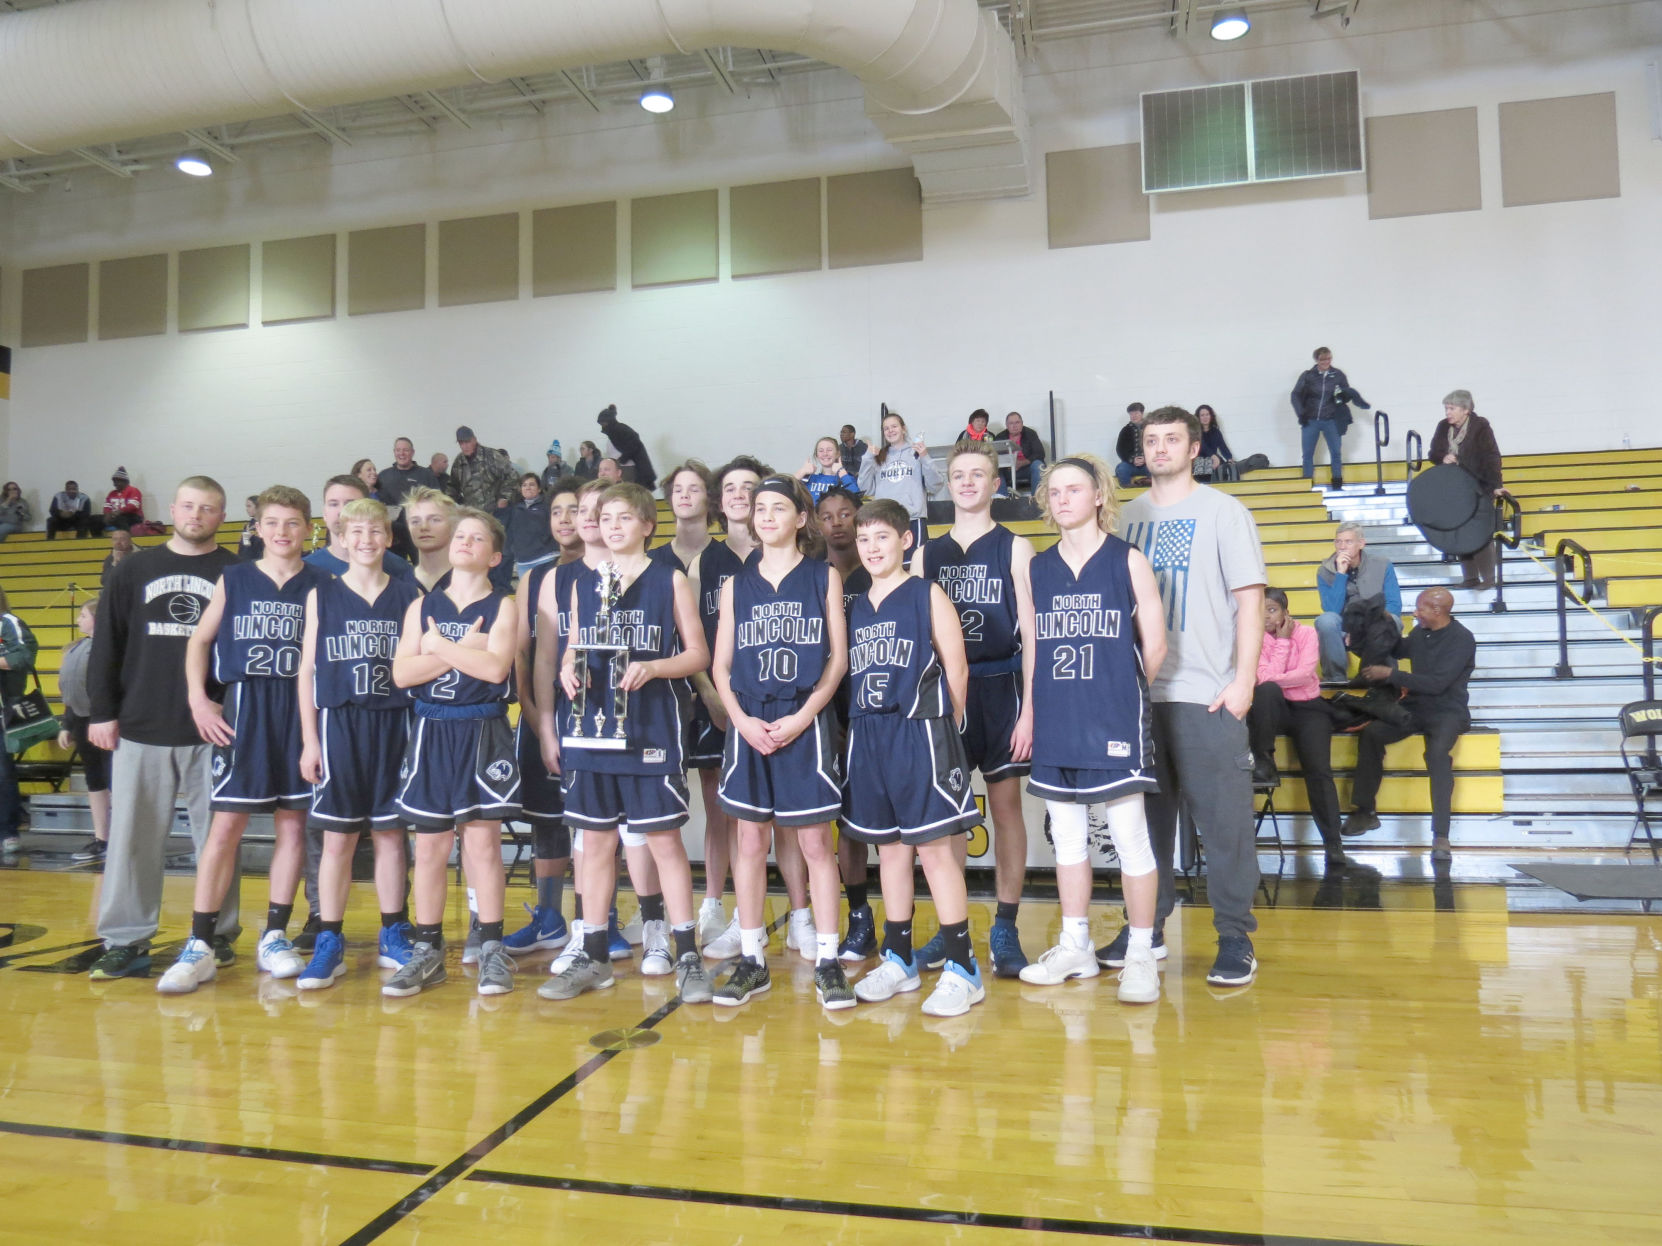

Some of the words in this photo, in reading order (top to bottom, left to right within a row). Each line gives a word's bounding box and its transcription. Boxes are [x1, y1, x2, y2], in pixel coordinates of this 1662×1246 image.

[880, 466, 913, 480] NORTH
[939, 565, 988, 580] NORTH
[145, 574, 183, 604] NORTH
[1052, 594, 1101, 611] NORTH
[251, 601, 303, 618] NORTH
[752, 602, 802, 620] NORTH
[1036, 609, 1121, 640] LINCOLN
[346, 619, 398, 635] NORTH
[579, 625, 662, 651] LICOLN
[738, 616, 823, 649] LINCOLN
[855, 621, 897, 644] NORTH
[245, 645, 303, 677] 20
[759, 647, 798, 682] 10
[849, 638, 914, 676] LINCOLN
[1053, 644, 1094, 680] 21
[353, 663, 391, 696] 12
[431, 668, 460, 699] 2
